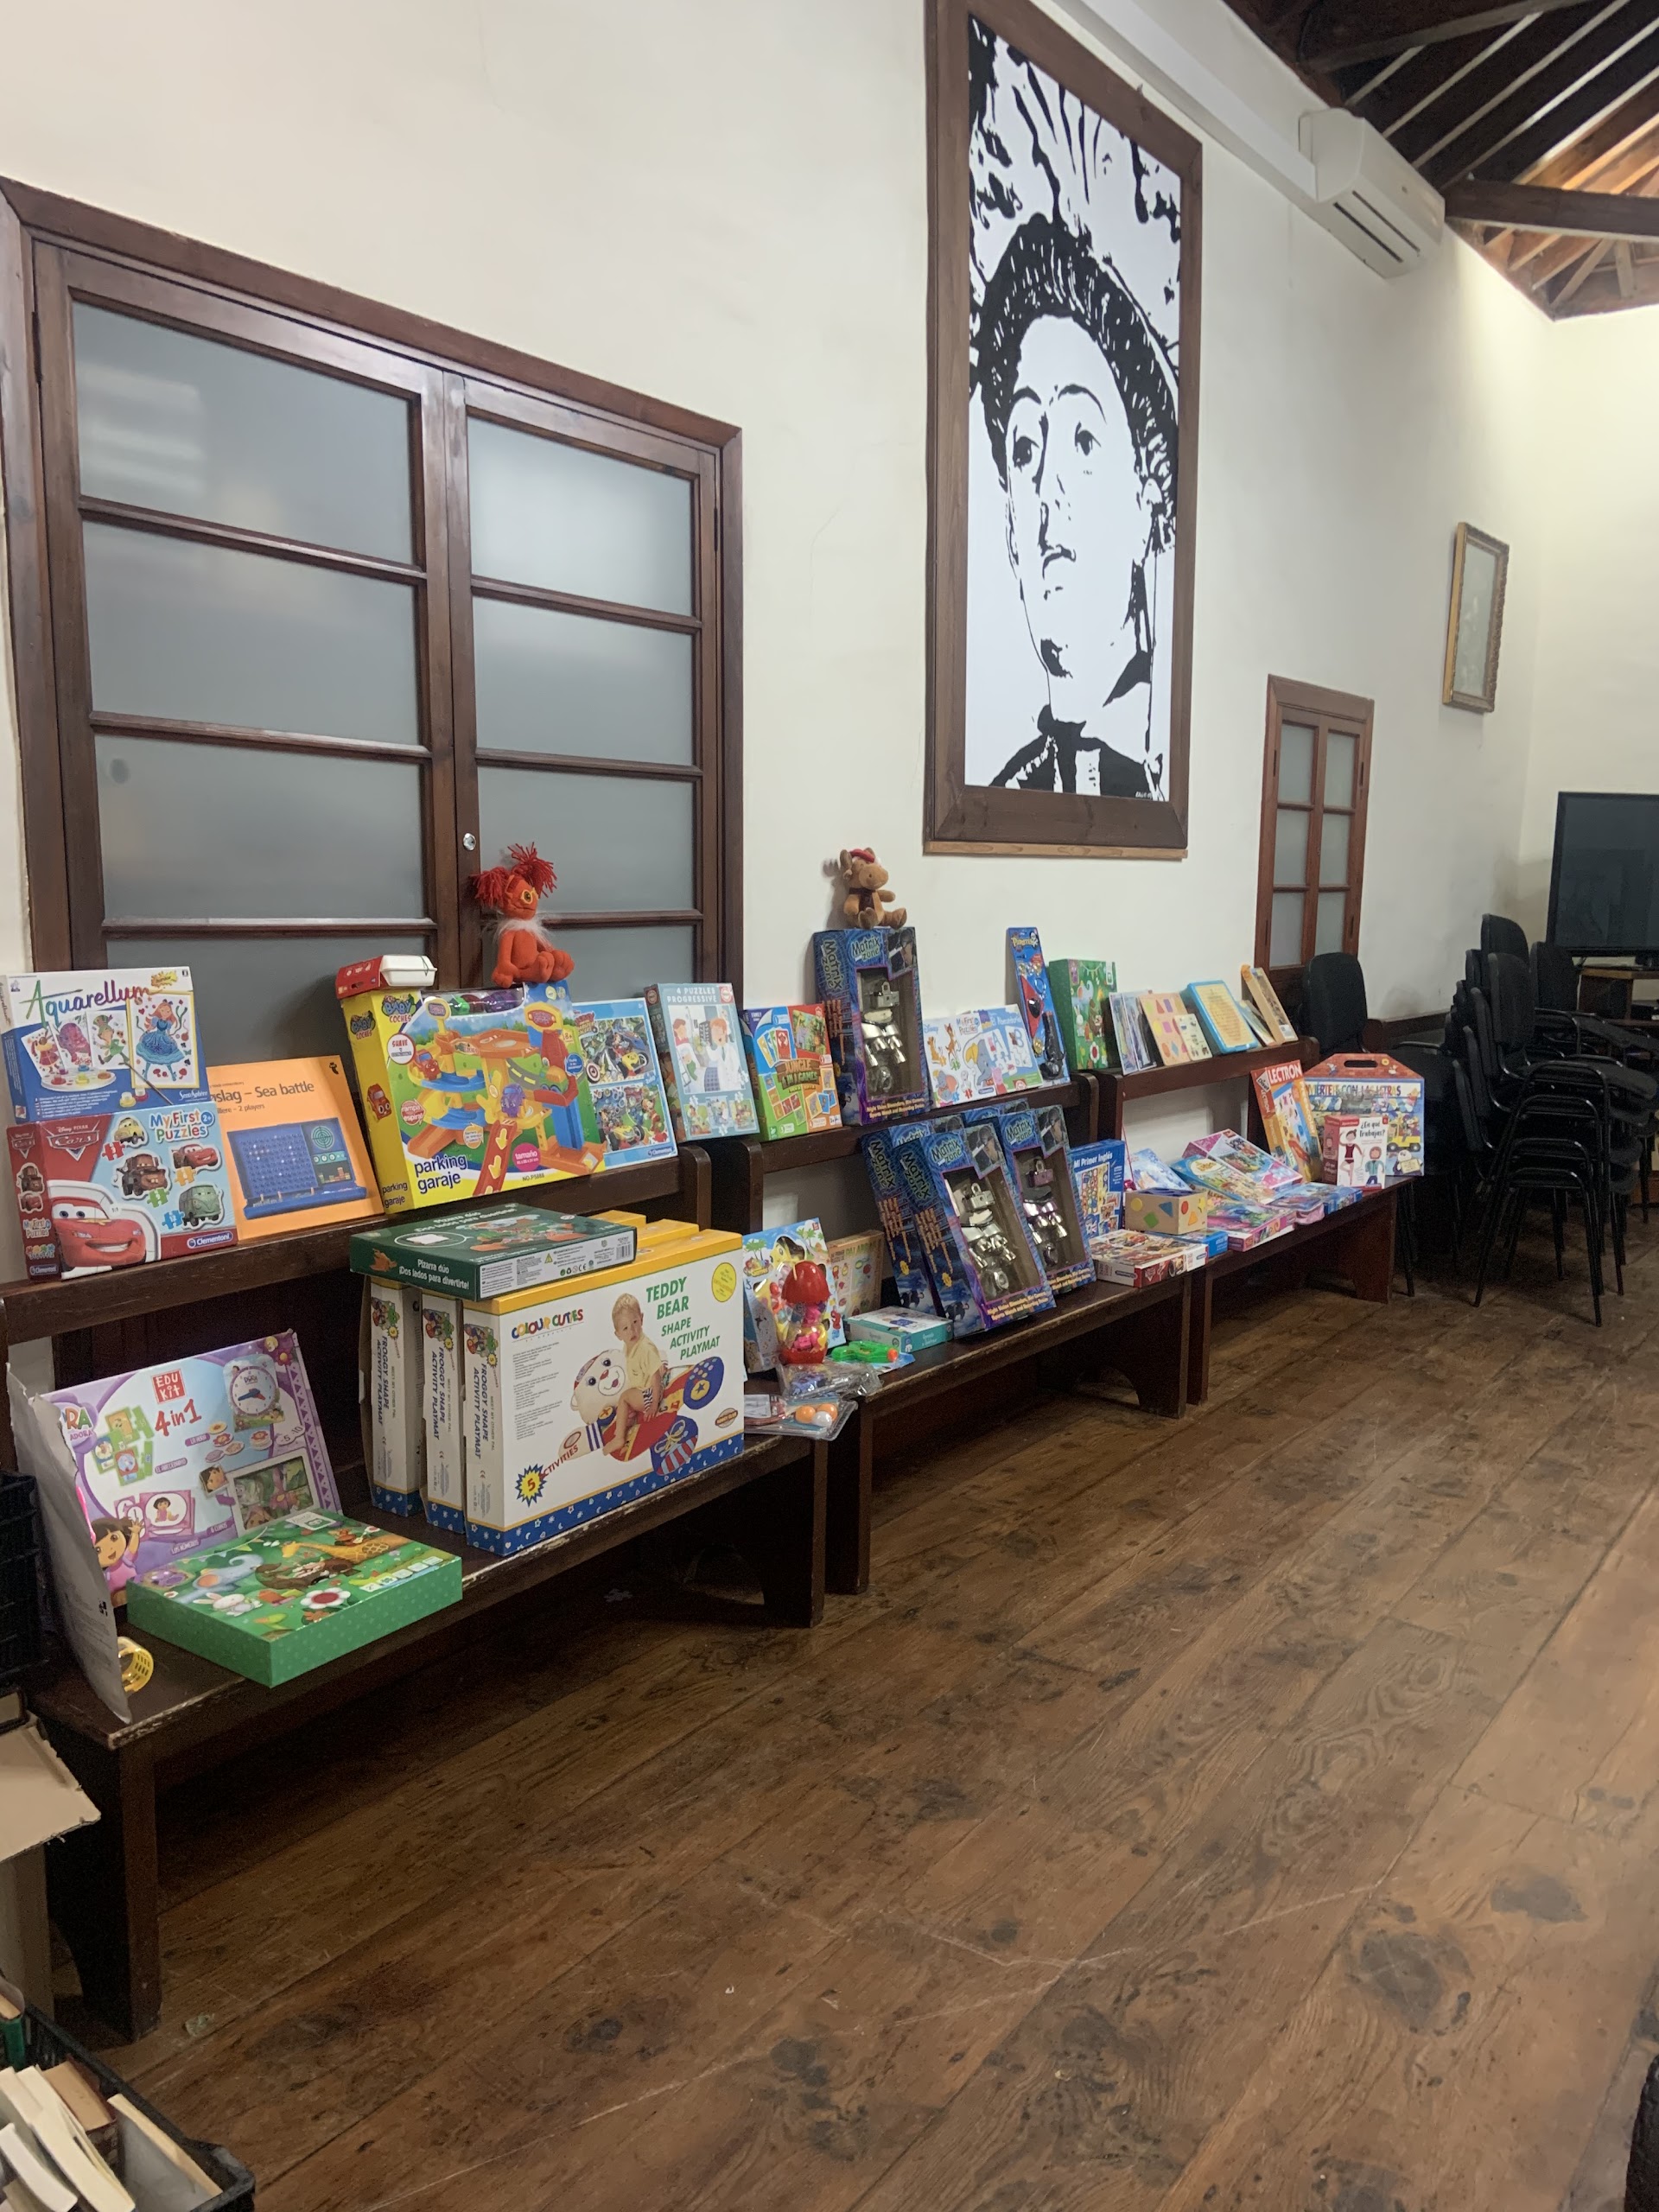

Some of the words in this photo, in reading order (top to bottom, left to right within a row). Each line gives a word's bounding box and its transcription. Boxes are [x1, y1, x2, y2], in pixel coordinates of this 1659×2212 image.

[852, 936, 880, 957] Matrix
[863, 948, 880, 959] zone
[824, 939, 842, 989] Matrix
[19, 979, 150, 1030] Aquarellum
[384, 1001, 411, 1015] BABY
[666, 995, 718, 1004] PROGRESSIVE
[389, 1014, 411, 1024] COCHES
[1268, 1062, 1303, 1084] LECTRON
[255, 1086, 277, 1098] Sea
[279, 1081, 315, 1096] battle
[245, 1103, 265, 1112] players
[150, 1114, 172, 1129] My
[172, 1110, 200, 1126] First
[202, 1113, 213, 1122] 2+
[156, 1126, 207, 1142] Puzzles
[1007, 1120, 1032, 1141] Matrix
[1015, 1128, 1033, 1142] zone
[931, 1140, 961, 1162] Matrix
[944, 1149, 963, 1164] zone
[414, 1154, 467, 1179] parking
[870, 1141, 897, 1187] Matrix
[417, 1173, 461, 1194] garaje
[902, 1151, 931, 1199] Matrix
[382, 1181, 408, 1194] parking
[384, 1195, 406, 1209] garaje
[196, 1232, 232, 1246] Clementoni
[417, 1258, 437, 1272] Pizarra
[438, 1263, 450, 1274] dúo
[398, 1265, 411, 1276] ¡Dos
[412, 1267, 428, 1281] lados
[429, 1274, 442, 1284] para
[442, 1274, 470, 1291] divertirte!
[645, 1276, 688, 1304] TEDDY
[657, 1295, 690, 1320] BEAR
[512, 1316, 551, 1339] COLOUR
[551, 1308, 584, 1327] CUTIES
[661, 1317, 691, 1338] SHAPE
[670, 1325, 710, 1350] ACTIVITY
[680, 1335, 721, 1361] PLAYMAT
[156, 1374, 179, 1388] EDU
[65, 1407, 93, 1430] RA
[155, 1410, 171, 1437] 4
[170, 1408, 186, 1427] in
[184, 1398, 201, 1424] 1
[527, 1477, 536, 1491] 5
